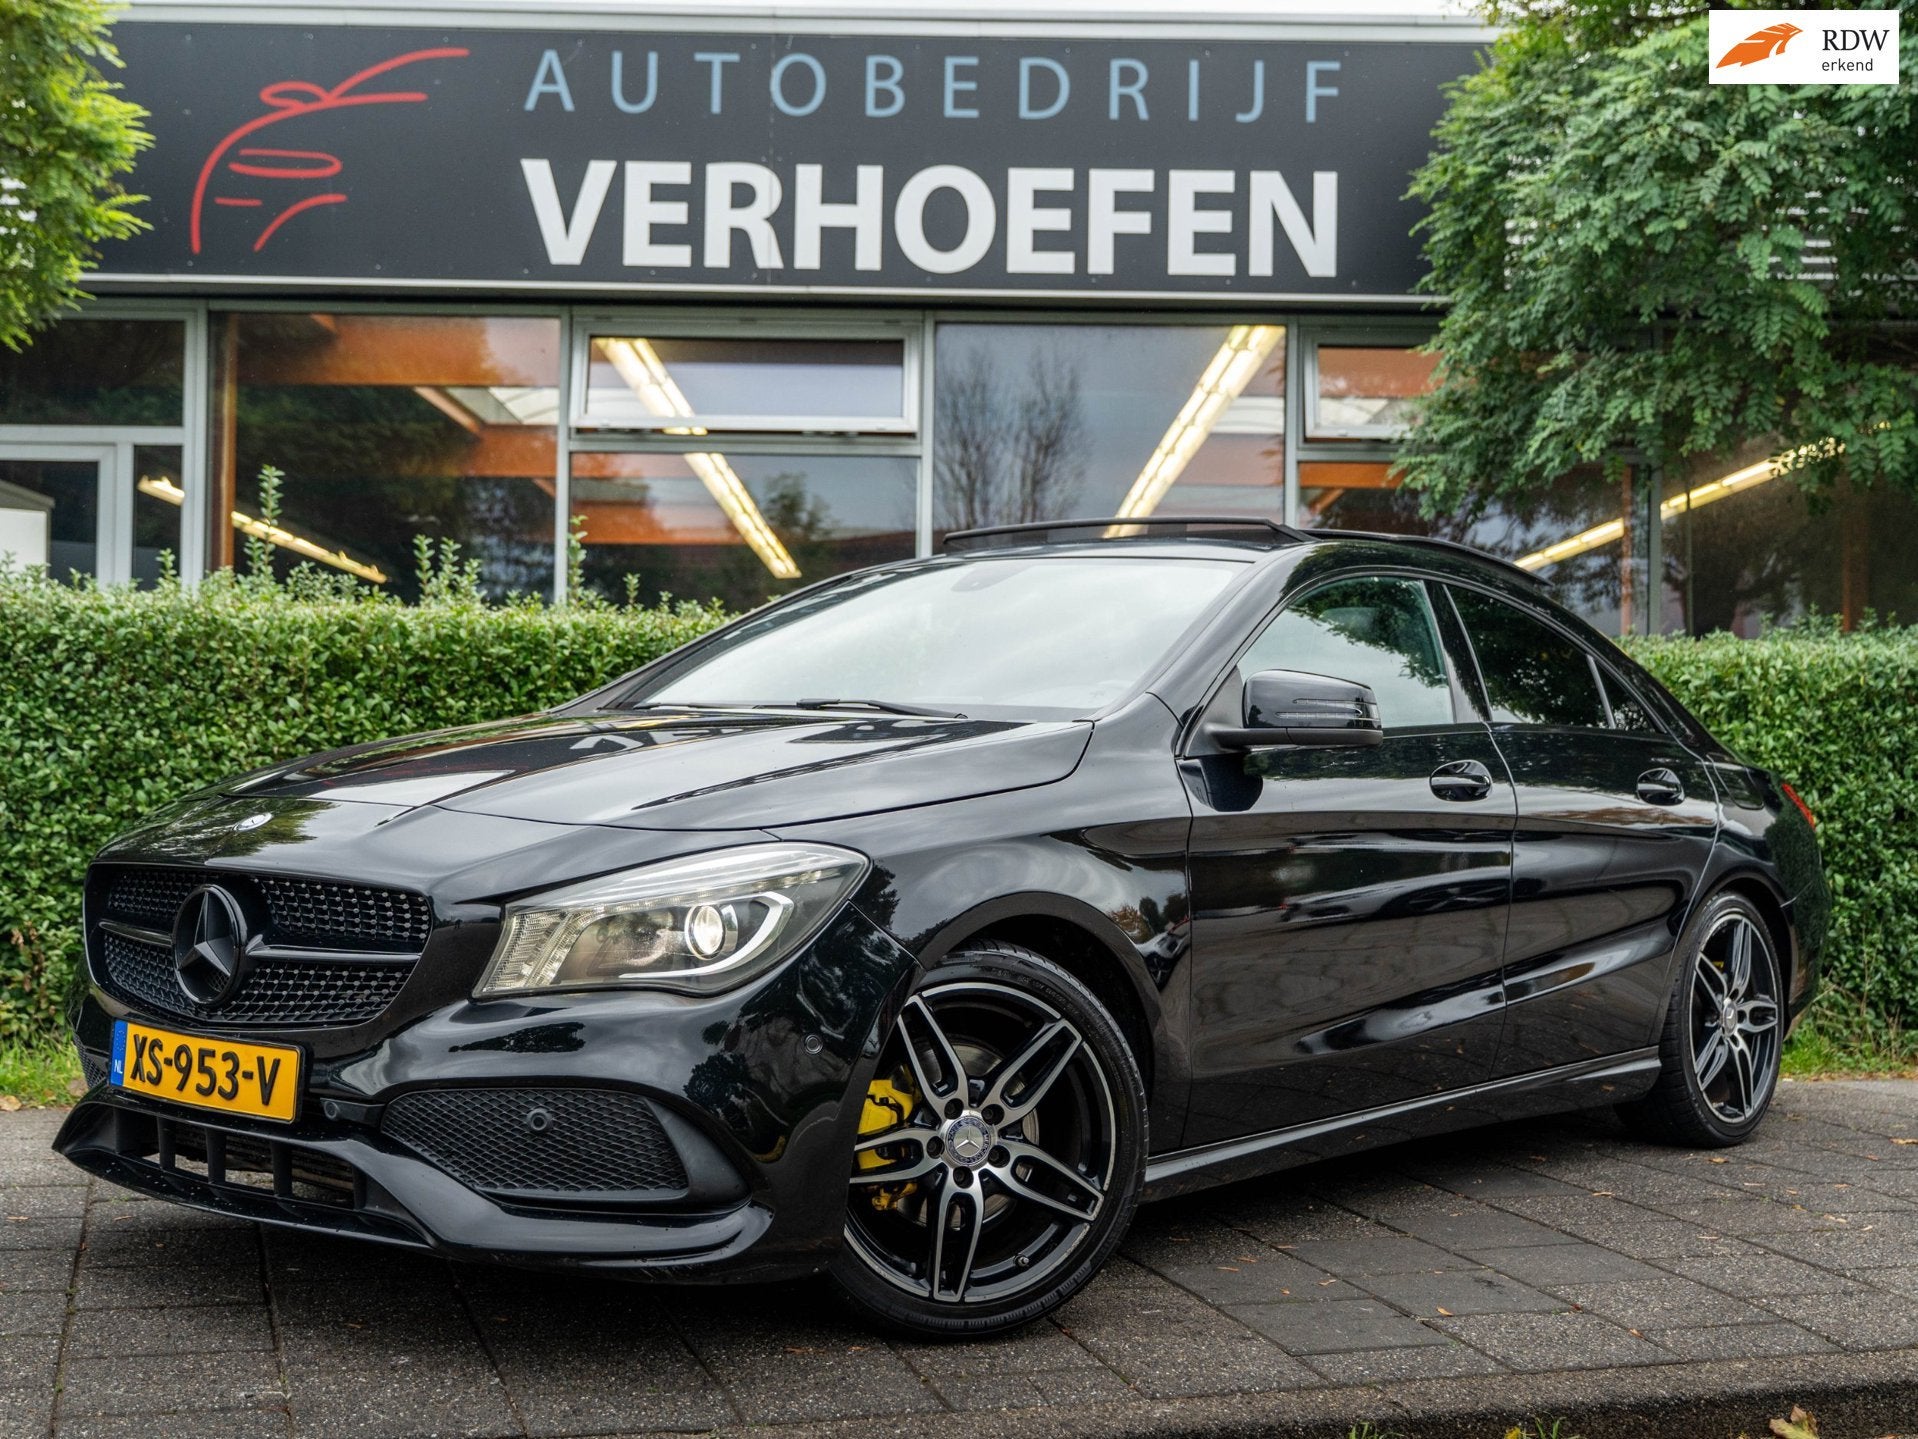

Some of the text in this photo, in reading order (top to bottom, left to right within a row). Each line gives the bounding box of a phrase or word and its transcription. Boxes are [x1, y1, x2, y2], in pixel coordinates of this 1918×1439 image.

[524, 49, 1341, 124] AUTOBEDRIJF
[521, 157, 1339, 279] VERHOEFEN
[114, 1058, 123, 1074] NL
[131, 1034, 281, 1105] XS-953-V
